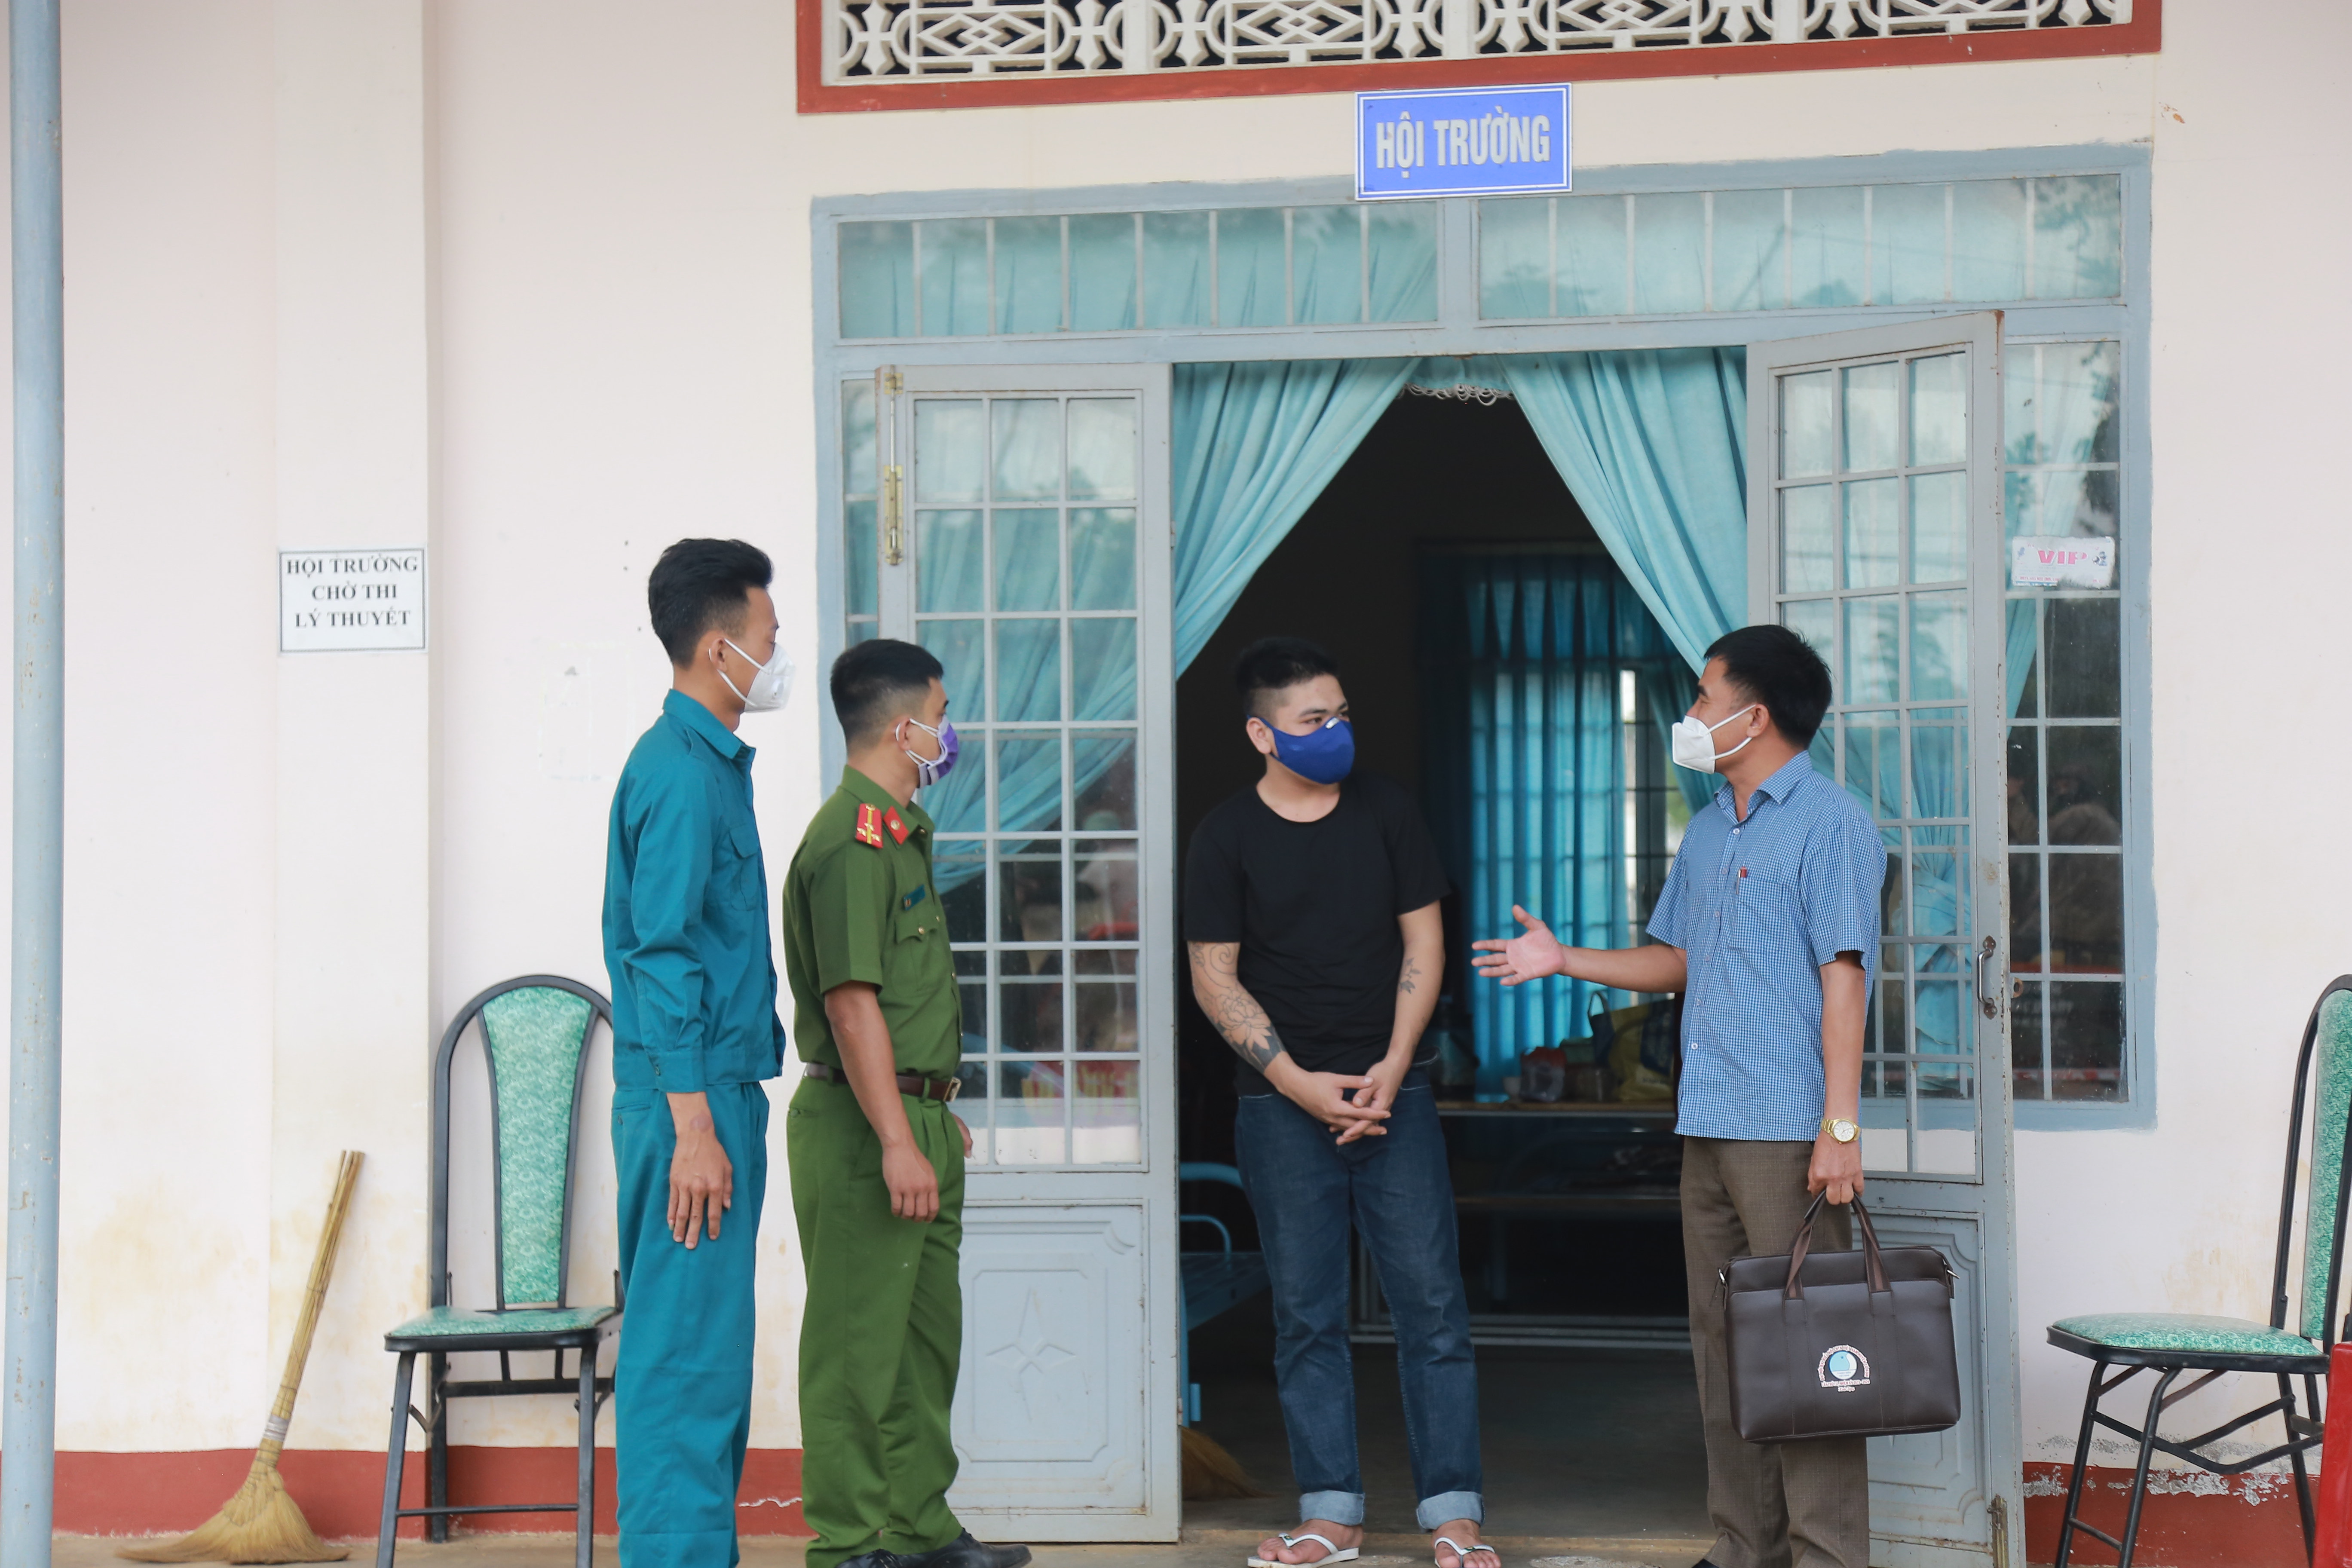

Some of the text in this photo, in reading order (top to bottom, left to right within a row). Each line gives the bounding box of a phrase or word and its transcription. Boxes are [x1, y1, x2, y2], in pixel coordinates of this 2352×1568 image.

[1377, 105, 1550, 178] HỘI TRƯỜNG
[287, 553, 418, 578] HỘI TRƯỜNG
[2038, 550, 2087, 564] VIP
[312, 580, 397, 600] CHỜ THI
[295, 606, 410, 628] LÝ THUYẾT
